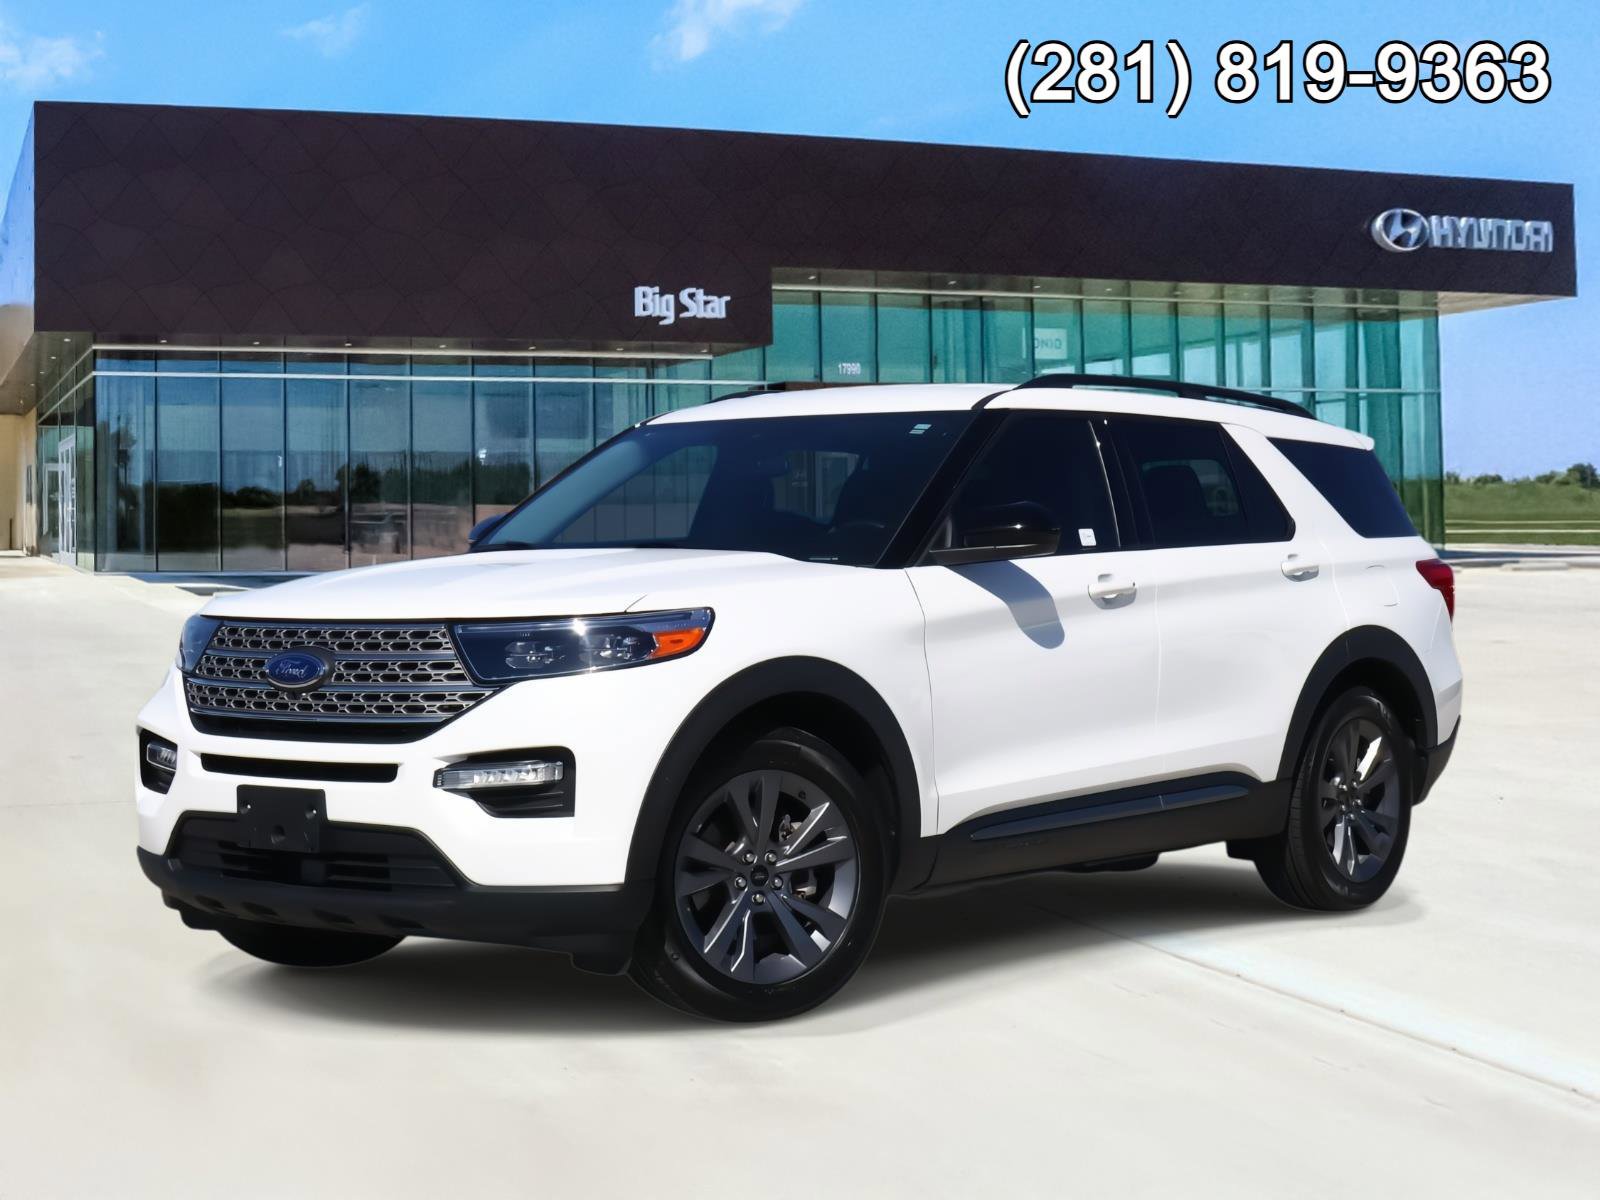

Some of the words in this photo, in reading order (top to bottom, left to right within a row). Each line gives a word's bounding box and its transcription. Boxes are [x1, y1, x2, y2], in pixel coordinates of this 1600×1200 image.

[1429, 215, 1553, 252] HYUNDAI
[634, 286, 675, 325] Big
[679, 287, 731, 318] Star
[275, 660, 308, 678] Ford
